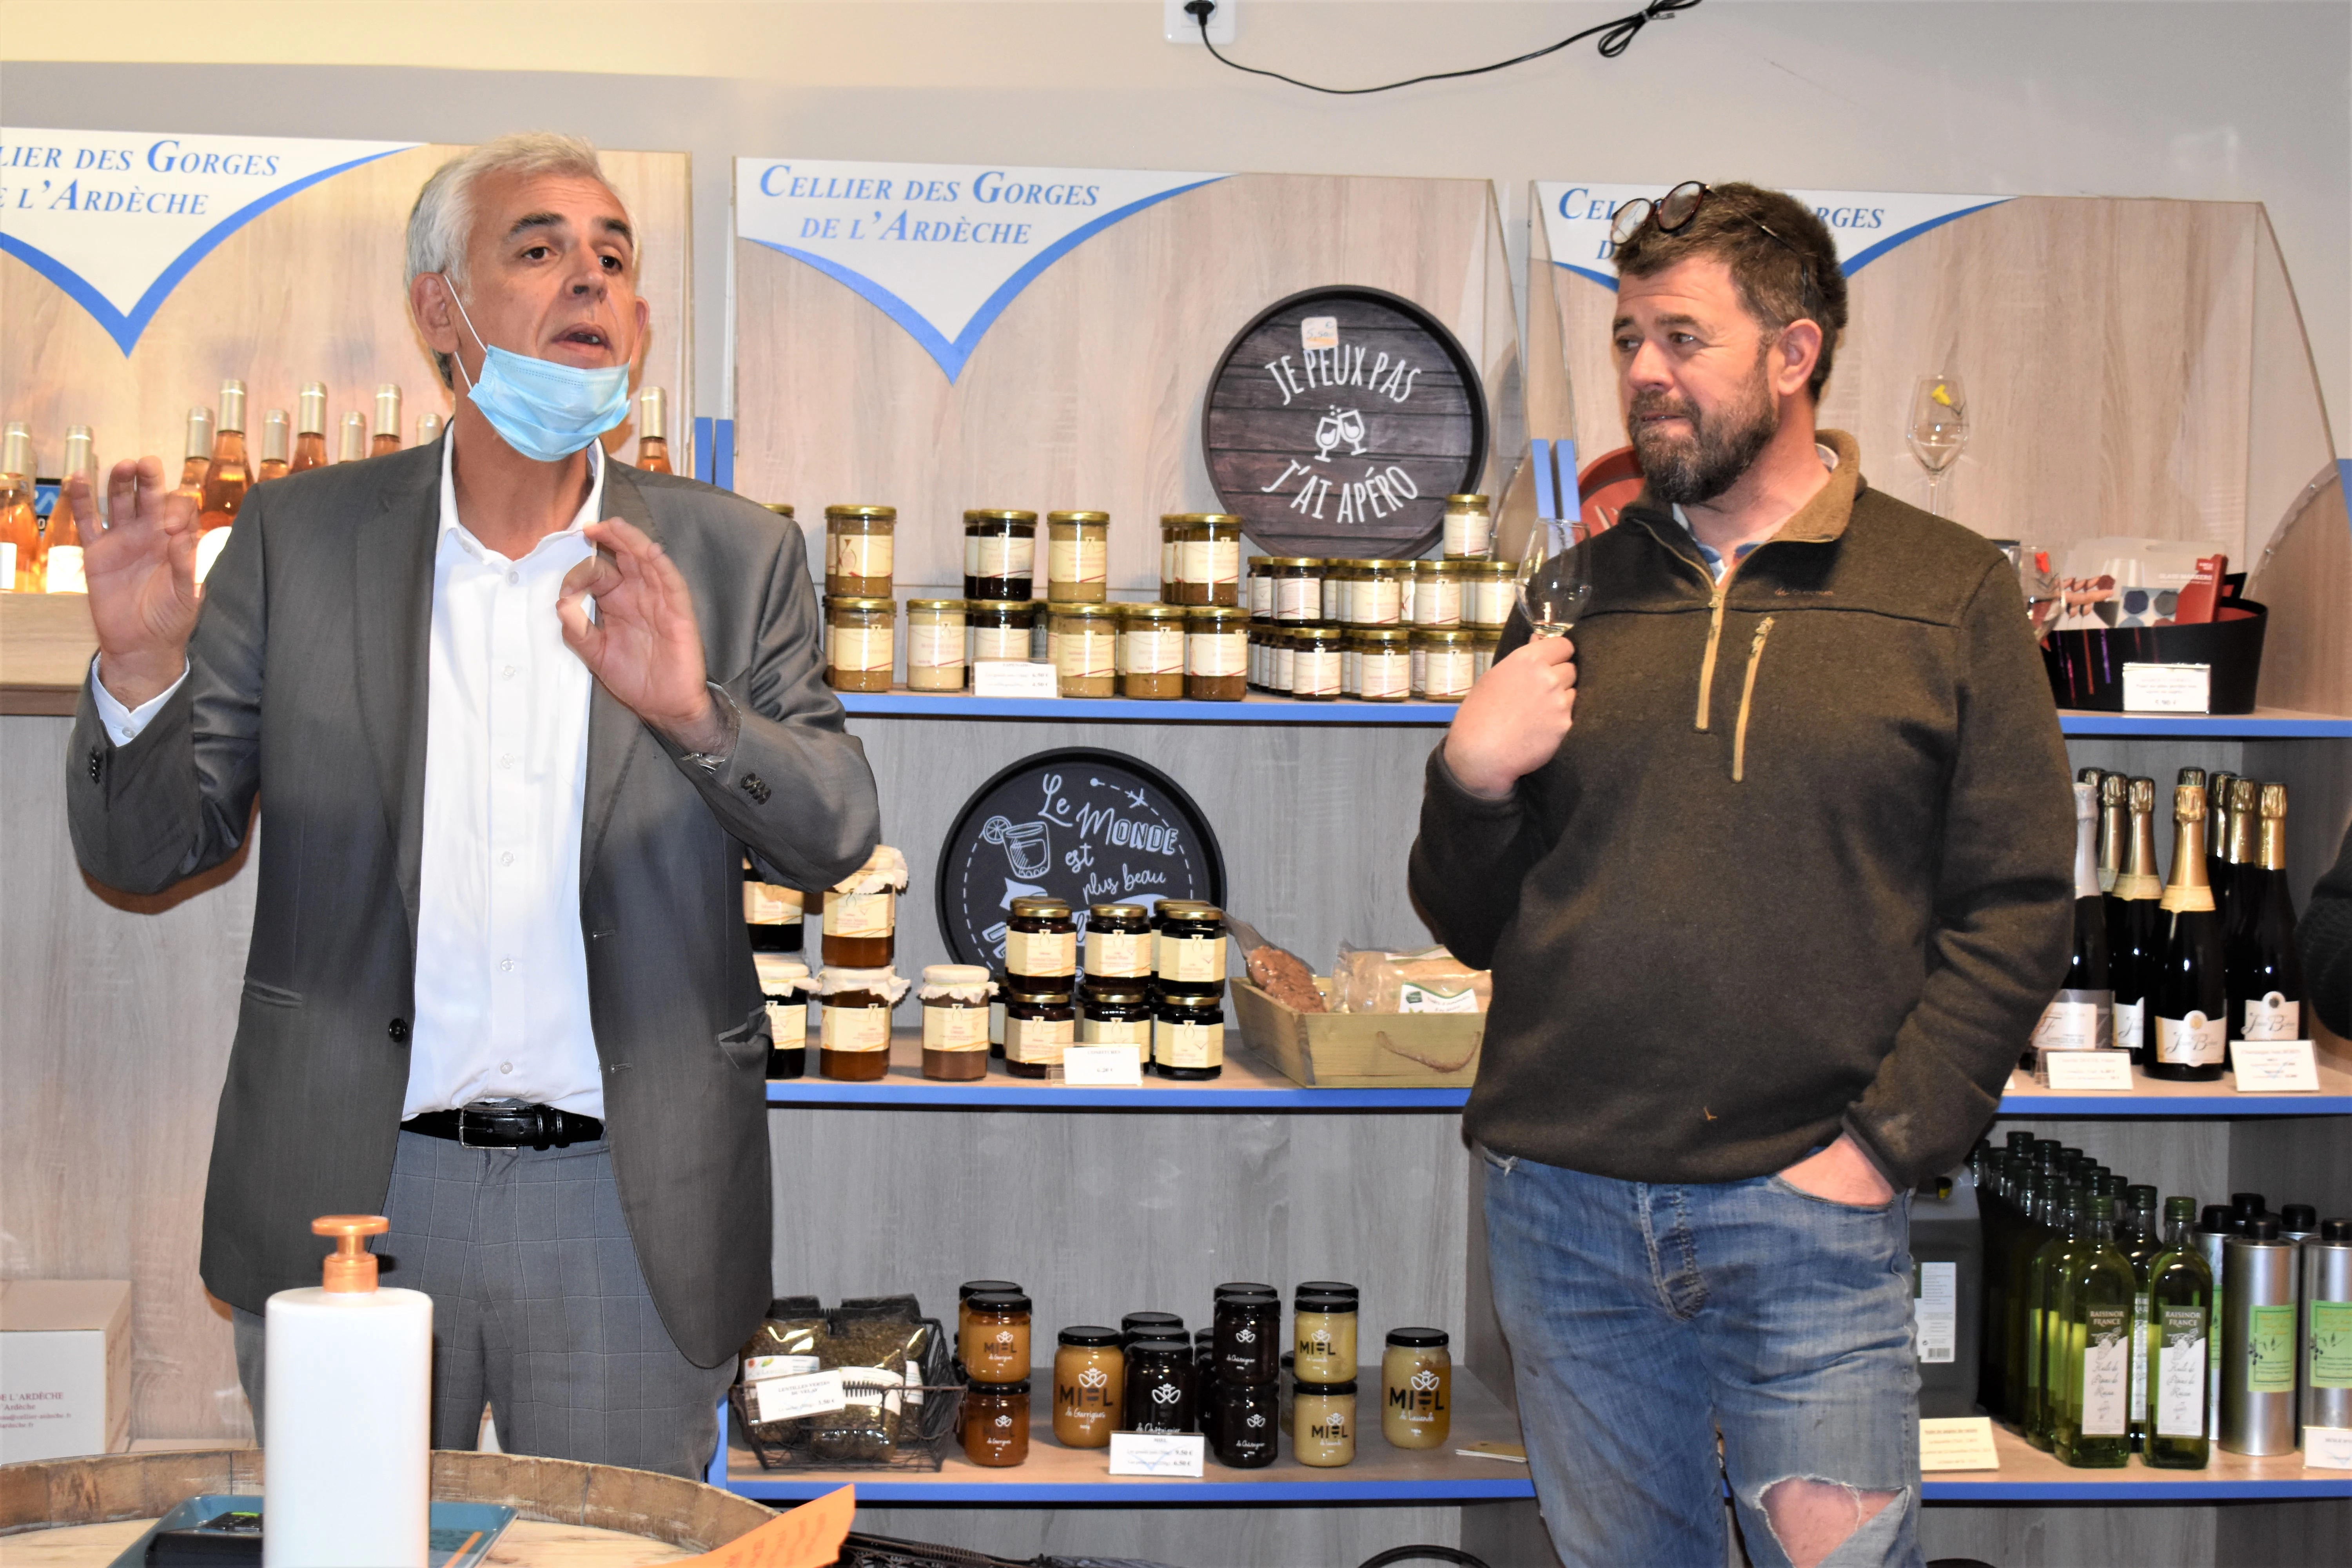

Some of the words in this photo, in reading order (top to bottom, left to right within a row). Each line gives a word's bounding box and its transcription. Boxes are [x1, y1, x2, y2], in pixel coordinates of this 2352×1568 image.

[74, 148, 132, 171] DES
[147, 140, 279, 176] GORGES
[17, 178, 209, 215] L'ARDÈCHE
[760, 165, 893, 201] CELLIER
[904, 180, 960, 202] DES
[973, 171, 1100, 206] GORGES
[800, 217, 839, 239] DE
[849, 211, 1032, 244] L'ARDÈCHE
[1816, 207, 1885, 229] RGES
[1264, 355, 1305, 405] JE
[1303, 344, 1366, 389] PEUX
[1368, 352, 1421, 403] PAS
[1261, 459, 1332, 519] J'AI
[1337, 466, 1418, 523] APÉRO
[1038, 774, 1073, 828] Le
[1065, 842, 1094, 873] est
[1083, 873, 1118, 905] plus
[1123, 863, 1166, 891] beau
[2093, 1318, 2121, 1327] FRANCE
[2169, 1319, 2198, 1328] FRANCE
[984, 1342, 1017, 1354] MIEL
[1300, 1340, 1336, 1355] MIEL
[9, 1391, 64, 1401] L'ARDÈCHE
[778, 1384, 808, 1392] LENTILLES
[1060, 1384, 1113, 1406] MIEL
[1389, 1387, 1445, 1410] MIEL
[1074, 1408, 1106, 1423] Garrigues
[1408, 1411, 1434, 1421] Lavande
[1311, 1425, 1348, 1438] MIEL
